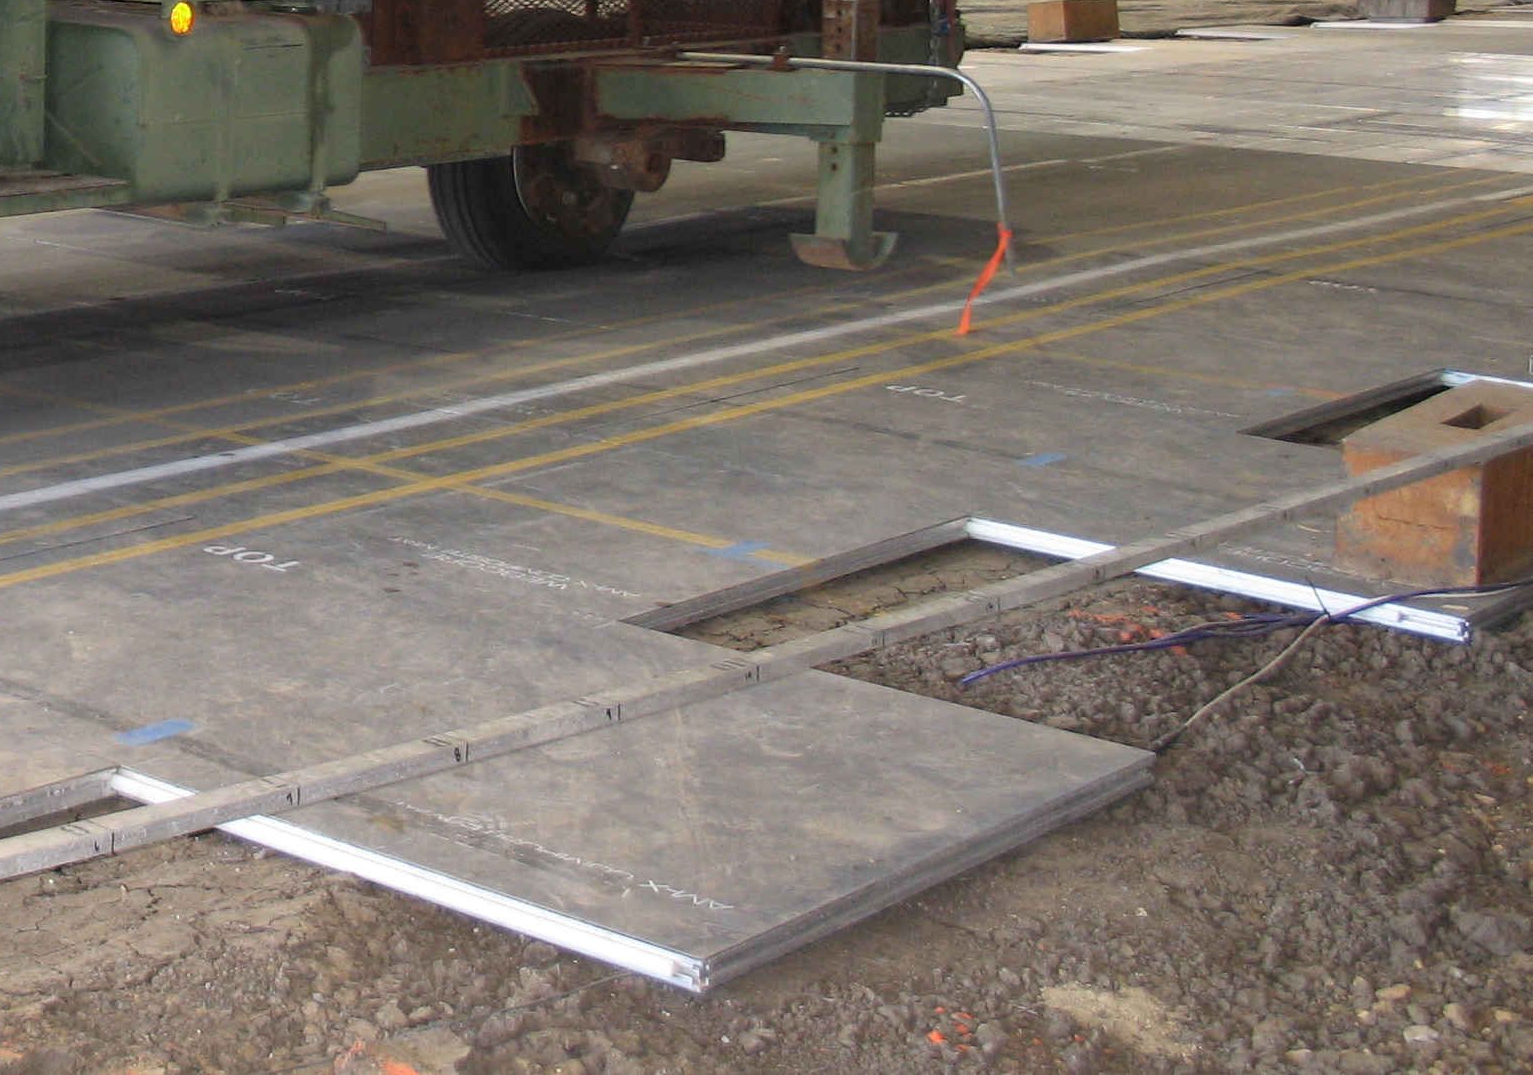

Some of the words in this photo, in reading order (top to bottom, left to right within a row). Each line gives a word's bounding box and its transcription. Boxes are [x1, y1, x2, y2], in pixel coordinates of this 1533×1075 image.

[885, 385, 966, 403] TOP
[203, 545, 300, 572] TOP
[453, 746, 462, 763] 8
[637, 879, 734, 910] AM-X
